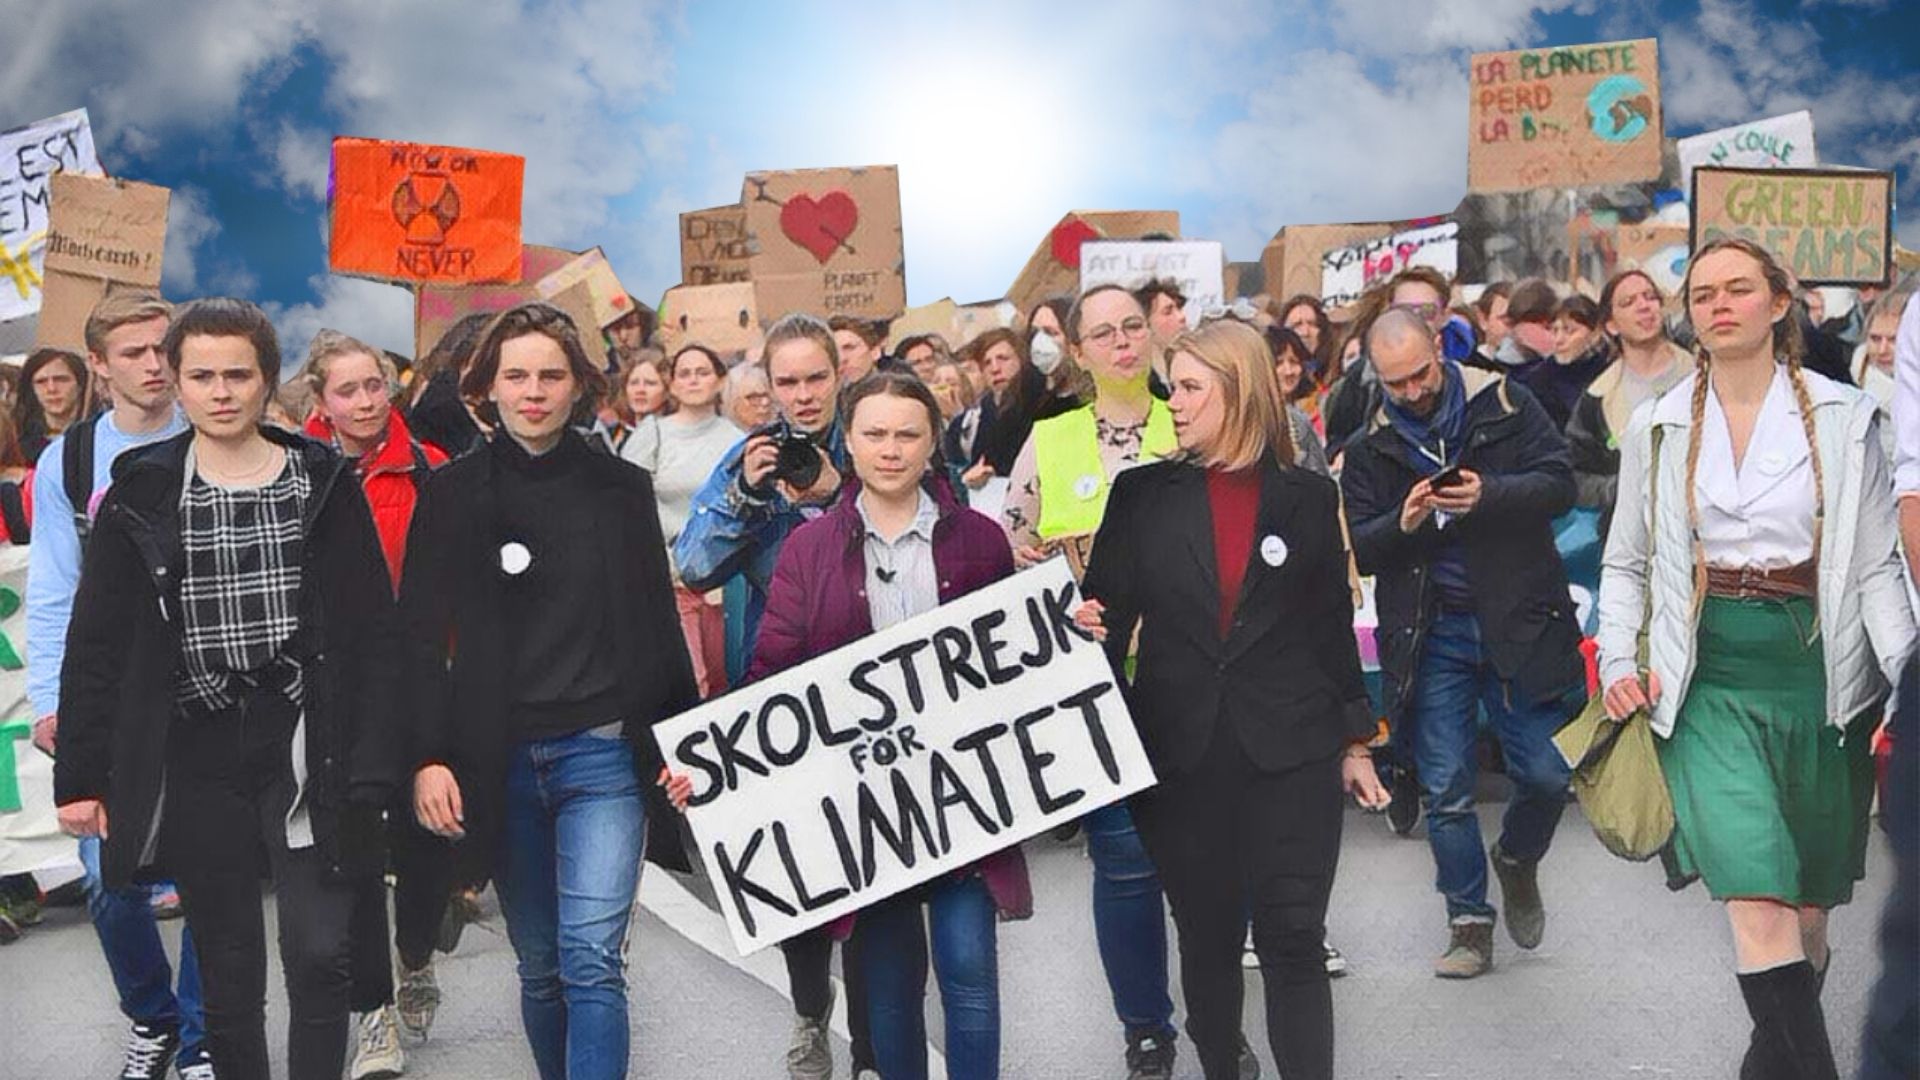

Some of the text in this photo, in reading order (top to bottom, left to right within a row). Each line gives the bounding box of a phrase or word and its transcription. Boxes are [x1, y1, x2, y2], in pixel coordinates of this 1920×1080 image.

[1476, 58, 1505, 84] LA
[1480, 84, 1552, 114] PERD
[1480, 118, 1509, 143] LA
[17, 129, 80, 181] EST
[1725, 177, 1864, 226] GREEN
[396, 247, 476, 276] NEVER
[1704, 225, 1881, 277] EAMS
[674, 581, 1095, 807] SKOLSTREJK
[849, 726, 925, 774] FÖR
[714, 681, 1121, 939] KLIMATET
